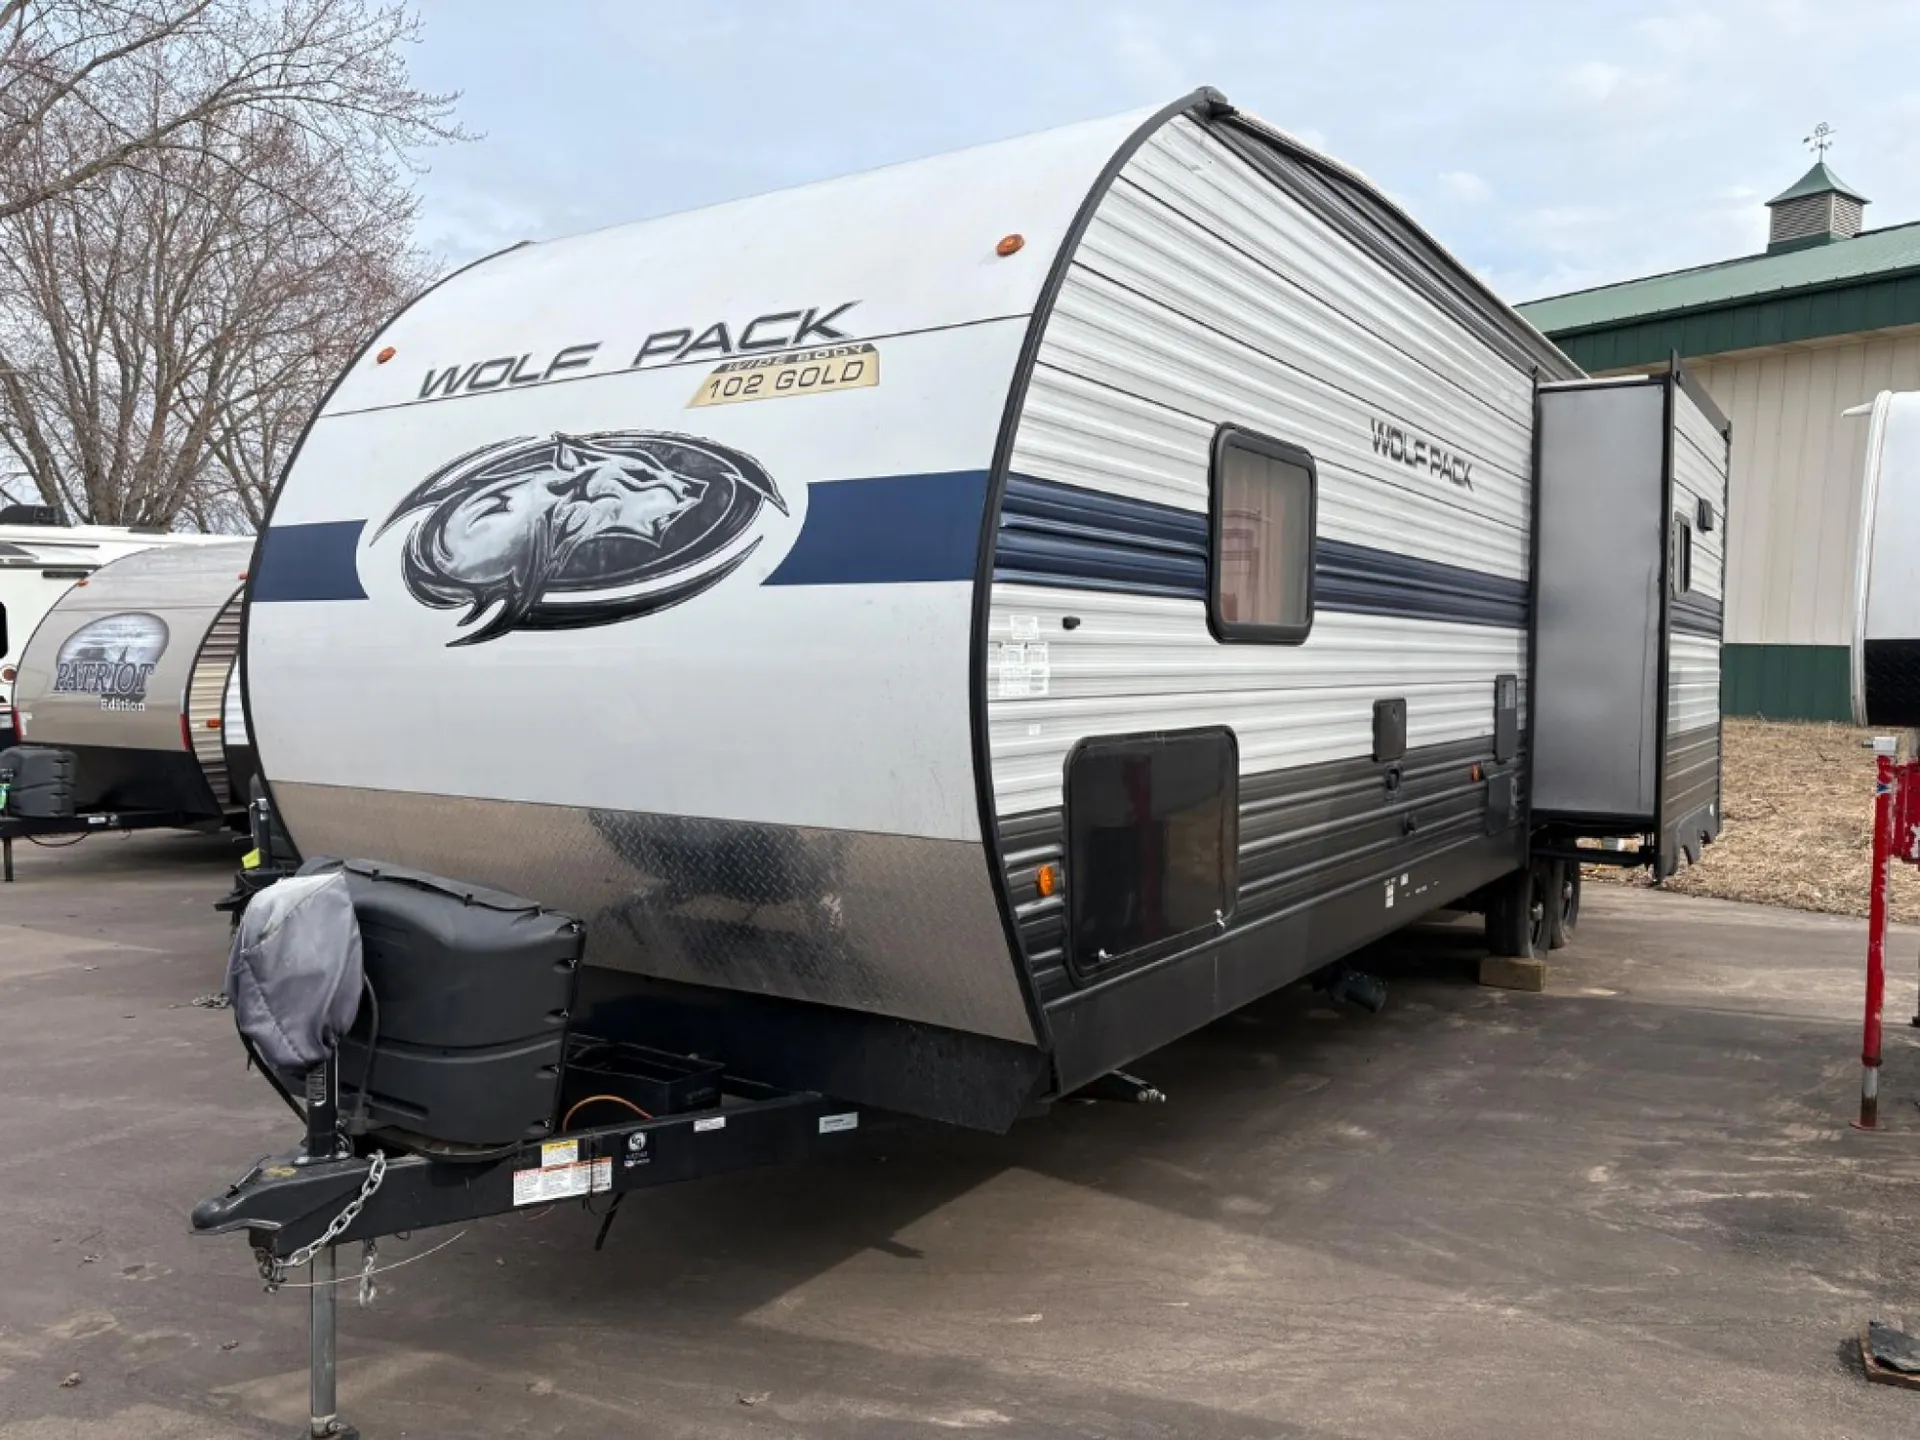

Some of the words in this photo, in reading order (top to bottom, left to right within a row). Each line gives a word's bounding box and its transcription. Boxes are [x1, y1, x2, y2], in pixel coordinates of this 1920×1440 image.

[418, 341, 603, 399] WOLF
[630, 300, 861, 367] PACK
[709, 374, 764, 399] 102
[775, 360, 864, 391] GOLD
[1370, 417, 1427, 467] WOLF
[1430, 445, 1474, 492] PACK
[53, 662, 155, 694] PATRIOT
[101, 698, 145, 711] Edition
